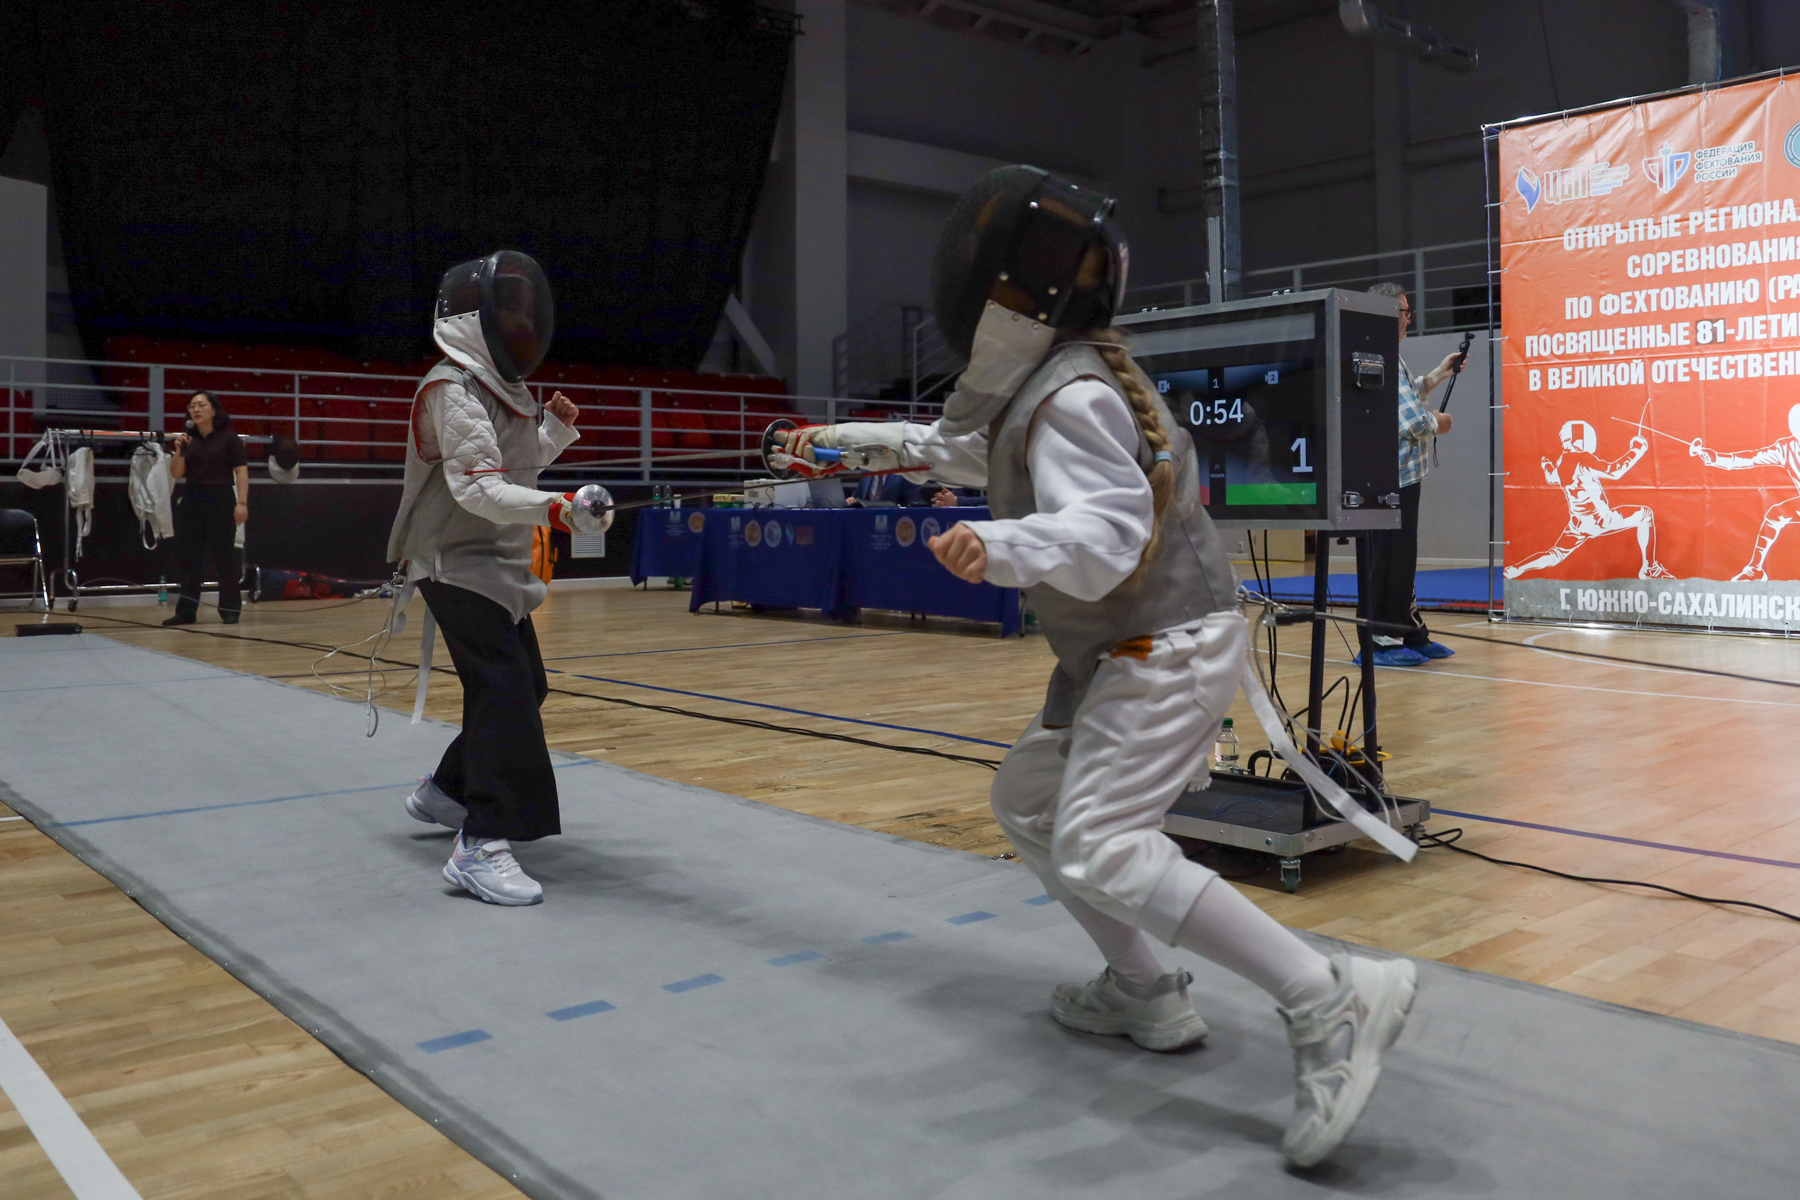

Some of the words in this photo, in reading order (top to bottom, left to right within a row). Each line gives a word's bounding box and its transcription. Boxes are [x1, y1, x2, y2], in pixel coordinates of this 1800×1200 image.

[1696, 142, 1754, 159] ФЕДЕРАЦИЯ
[1696, 152, 1761, 171] ФЕХТОВАНИЯ
[1696, 168, 1736, 181] РОССИИ
[1563, 214, 1681, 251] ОТКРЫТЫЕ
[1689, 198, 1800, 235] РЕГИОНА
[1565, 296, 1592, 319] ПО
[1599, 278, 1760, 315] ФЕХТОВАНИЮ
[1525, 322, 1690, 357] ПОСВЯЩЕННЫЕ
[1696, 312, 1800, 344] 81-ЛЕТИ
[1212, 378, 1220, 389] 1
[1529, 369, 1541, 391] В
[1548, 359, 1644, 389] ВЕЛИКОЙ
[1652, 350, 1800, 385] ОТЕЧЕСТВЕН
[1189, 398, 1244, 426] 0:54
[1290, 437, 1313, 473] 1
[1559, 588, 1571, 610] Г.
